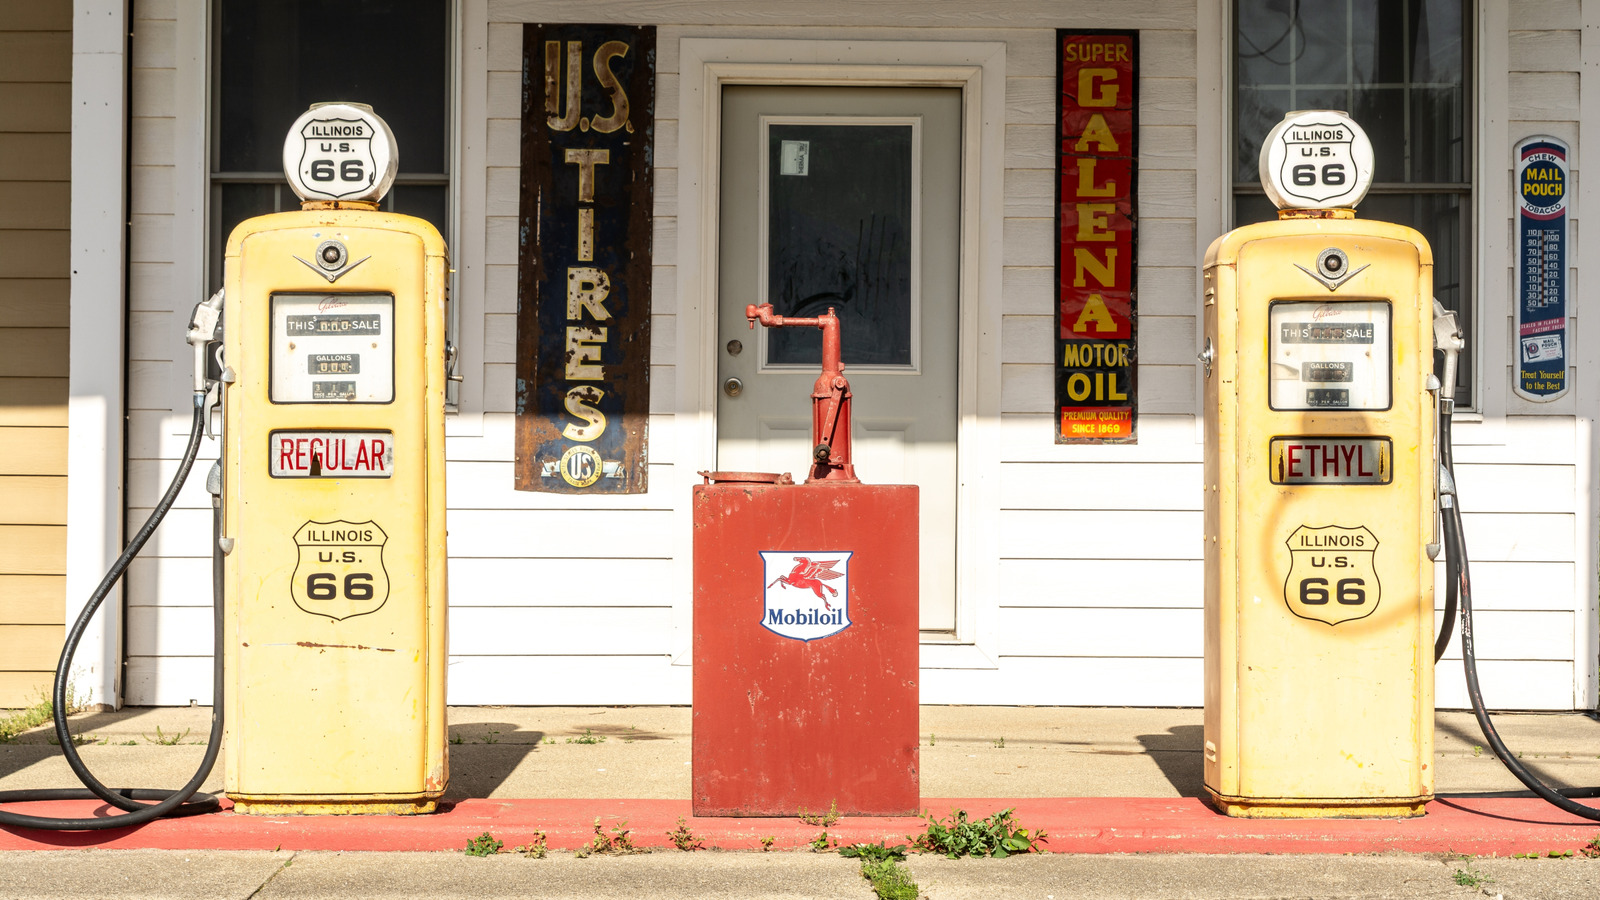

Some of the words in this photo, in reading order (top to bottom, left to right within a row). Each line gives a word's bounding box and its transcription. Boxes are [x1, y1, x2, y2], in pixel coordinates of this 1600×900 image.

[1066, 43, 1129, 62] SUPER
[545, 41, 635, 134] U.S.
[312, 126, 363, 136] ILLINOIS
[1292, 130, 1343, 141] ILLINOIS
[320, 143, 355, 152] U.S.
[1301, 147, 1336, 157] U.S.
[1528, 153, 1556, 162] CHEW
[311, 159, 364, 182] 66
[1292, 163, 1345, 186] 66
[1526, 168, 1562, 180] MAIL
[1523, 183, 1562, 196] POUCH
[1073, 67, 1119, 332] GALENA
[1524, 202, 1561, 214] TOBACCO
[562, 149, 613, 442] TIRES
[288, 321, 315, 330] THIS
[352, 320, 379, 329] SALE
[1283, 329, 1309, 338] THIS
[1346, 329, 1372, 338] SALE
[1064, 343, 1129, 367] MOTOR
[1521, 370, 1536, 379] Treat
[1539, 370, 1564, 379] Yourself
[1067, 372, 1127, 402] OIL
[1064, 412, 1097, 421] PREMIUM
[1099, 412, 1129, 422] QUALITY
[1072, 424, 1095, 433] SINCE
[1098, 424, 1120, 433] 1869
[280, 438, 385, 470] REGULAR
[570, 452, 592, 480] US
[1288, 445, 1373, 477] ETHYL
[308, 530, 373, 542] ILLINOIS
[1301, 535, 1364, 547] ILLINOIS
[318, 552, 362, 563] U.S.
[1312, 556, 1354, 568] U.S.
[306, 572, 374, 600] 66
[1300, 578, 1365, 605] 66
[768, 608, 843, 626] Mobiloil
